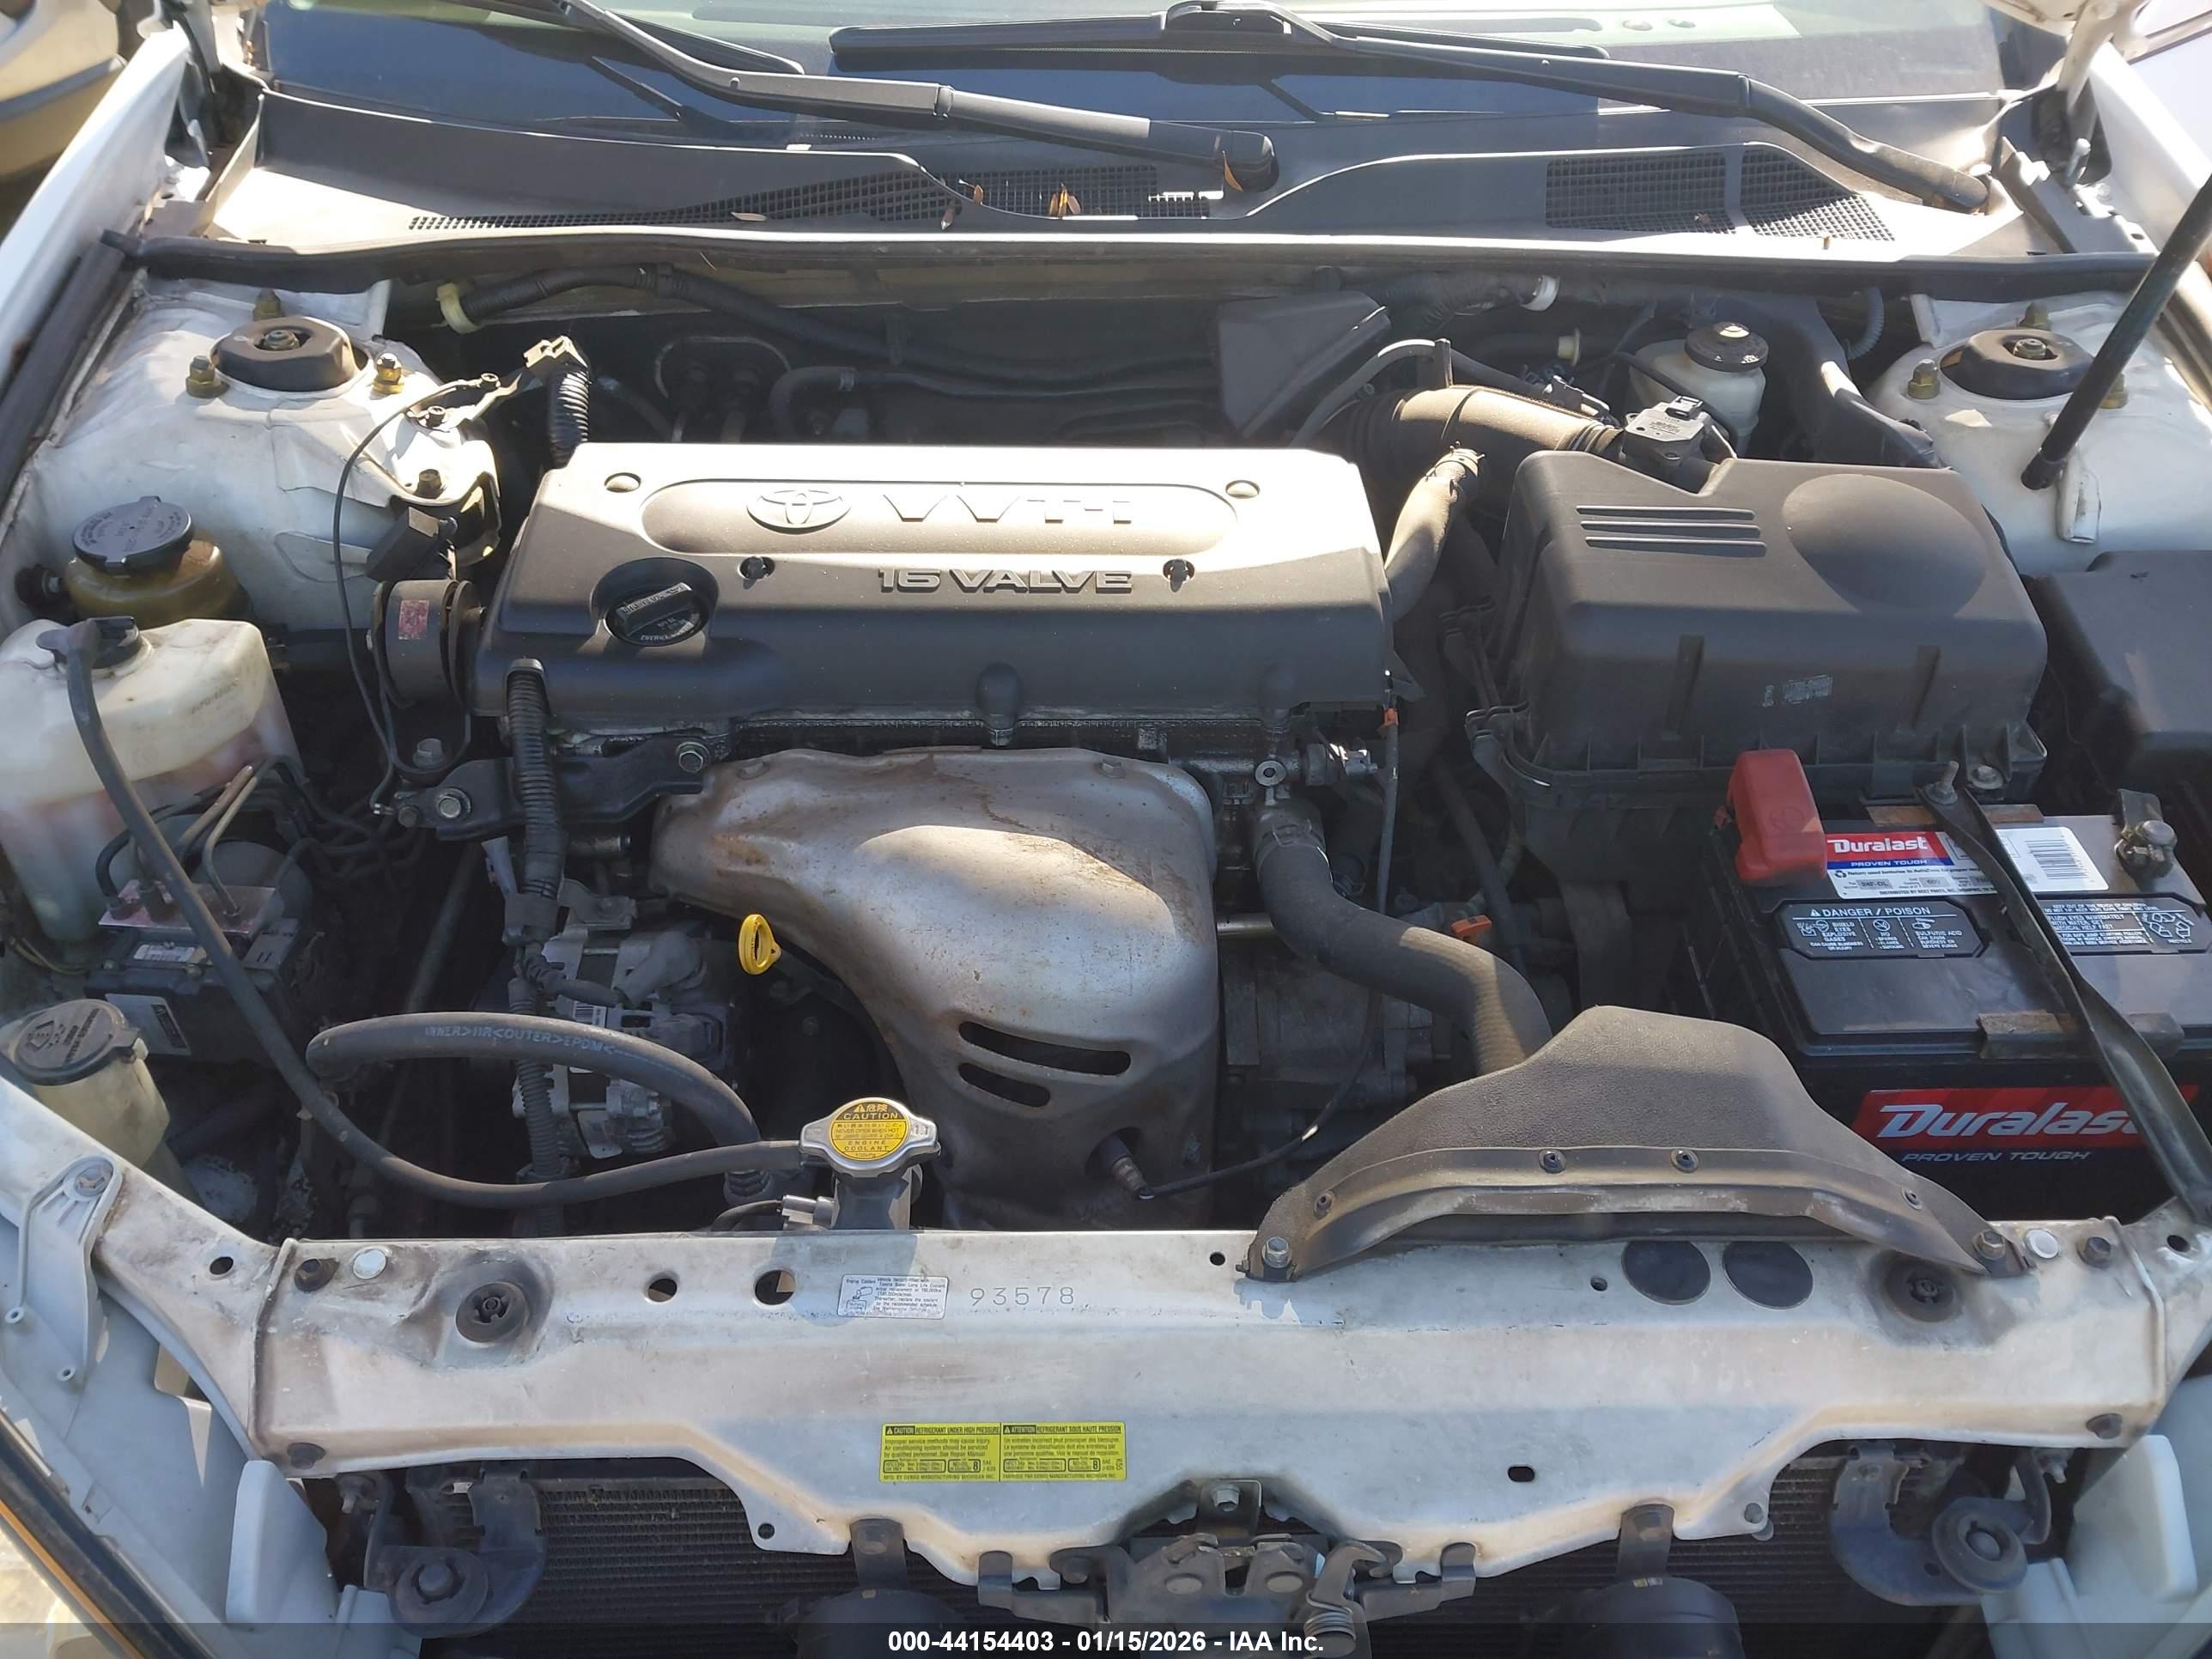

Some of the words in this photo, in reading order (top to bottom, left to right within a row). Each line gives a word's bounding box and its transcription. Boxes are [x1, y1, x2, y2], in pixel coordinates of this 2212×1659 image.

[878, 567, 941, 592] 16
[949, 568, 1132, 593] VALVE
[1827, 836, 1929, 854] Duralast
[1821, 908, 1872, 917] DANGER
[1887, 907, 1931, 915] POISON
[1877, 1102, 2138, 1138] Duralas
[1902, 1152, 2002, 1162] PROVEN
[2009, 1152, 2091, 1161] TOUGH
[970, 1286, 1073, 1306] 93578
[972, 1462, 979, 1471] 8
[1092, 1460, 1098, 1470] 8
